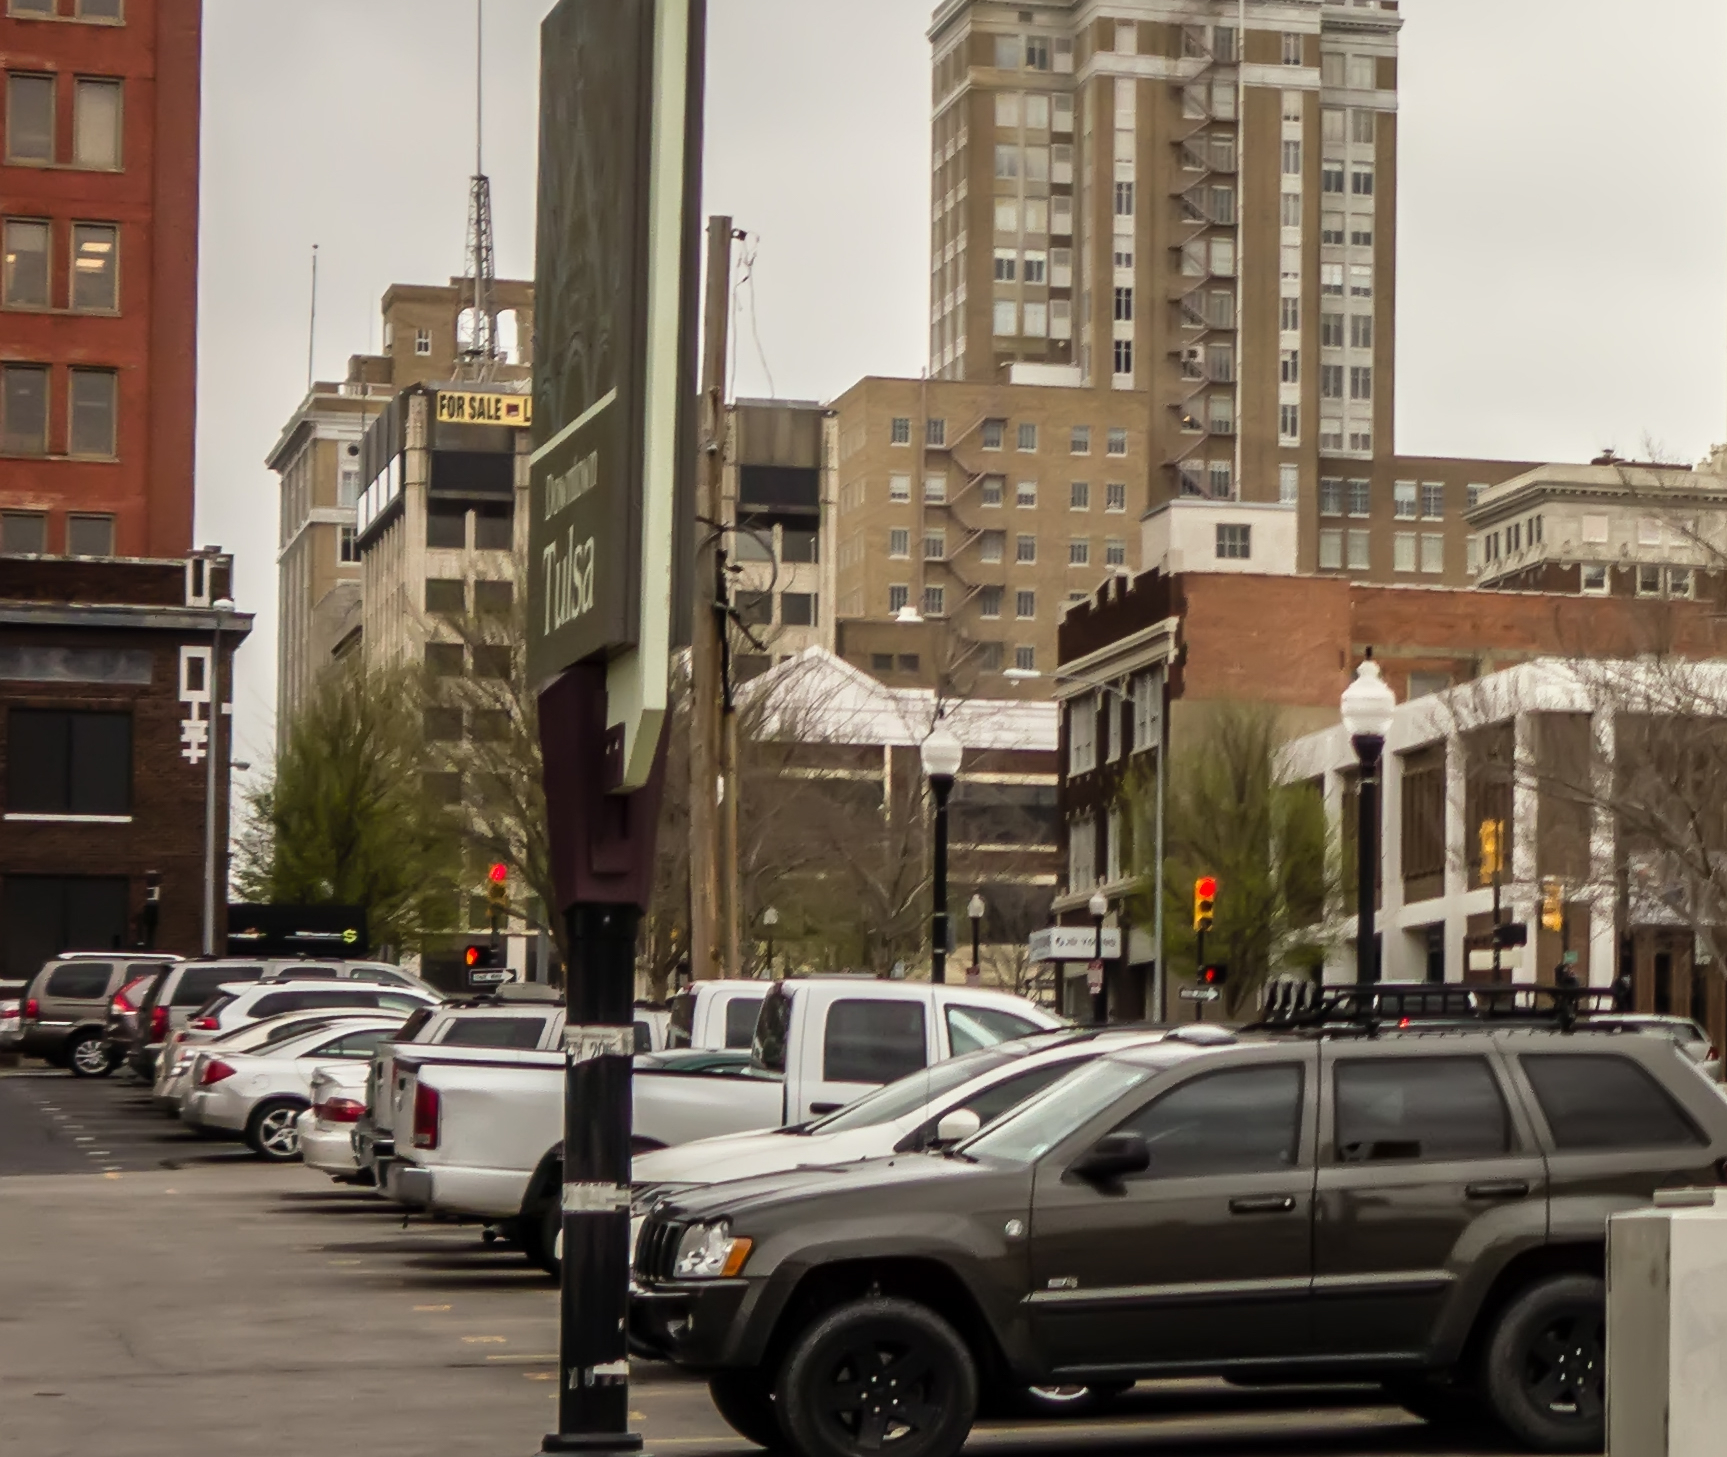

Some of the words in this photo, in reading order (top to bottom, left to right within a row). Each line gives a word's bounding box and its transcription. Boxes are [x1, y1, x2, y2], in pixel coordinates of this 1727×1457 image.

[438, 394, 466, 419] FOR
[468, 395, 503, 422] SALE
[543, 523, 595, 636] Tulsa
